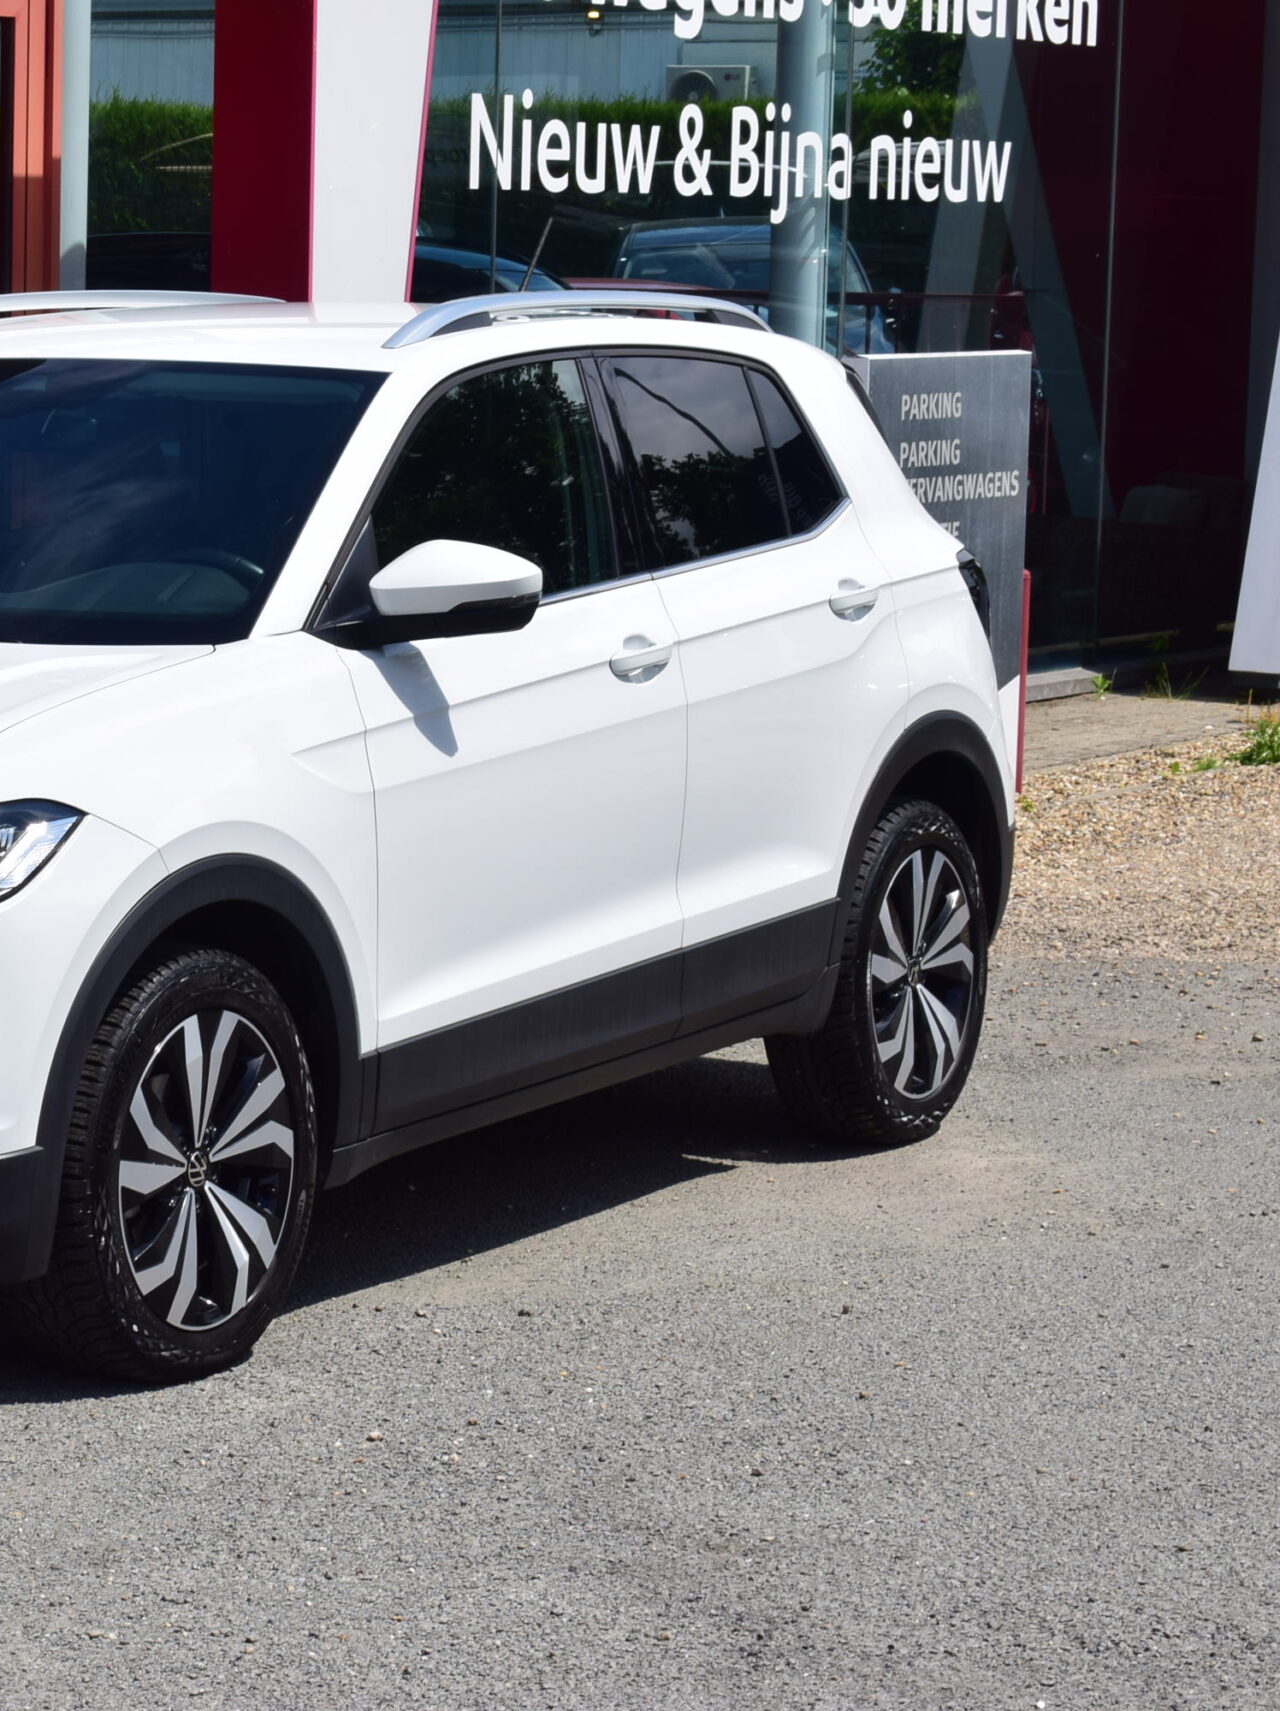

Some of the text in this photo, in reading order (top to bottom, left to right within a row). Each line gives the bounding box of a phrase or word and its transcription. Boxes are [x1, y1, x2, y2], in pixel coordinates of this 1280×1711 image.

[467, 88, 1013, 223] Nieuw & Bijna nieuw
[901, 392, 962, 421] PARKING
[899, 438, 961, 469] PARKING
[906, 469, 1020, 504] ERVANGWAGENS
